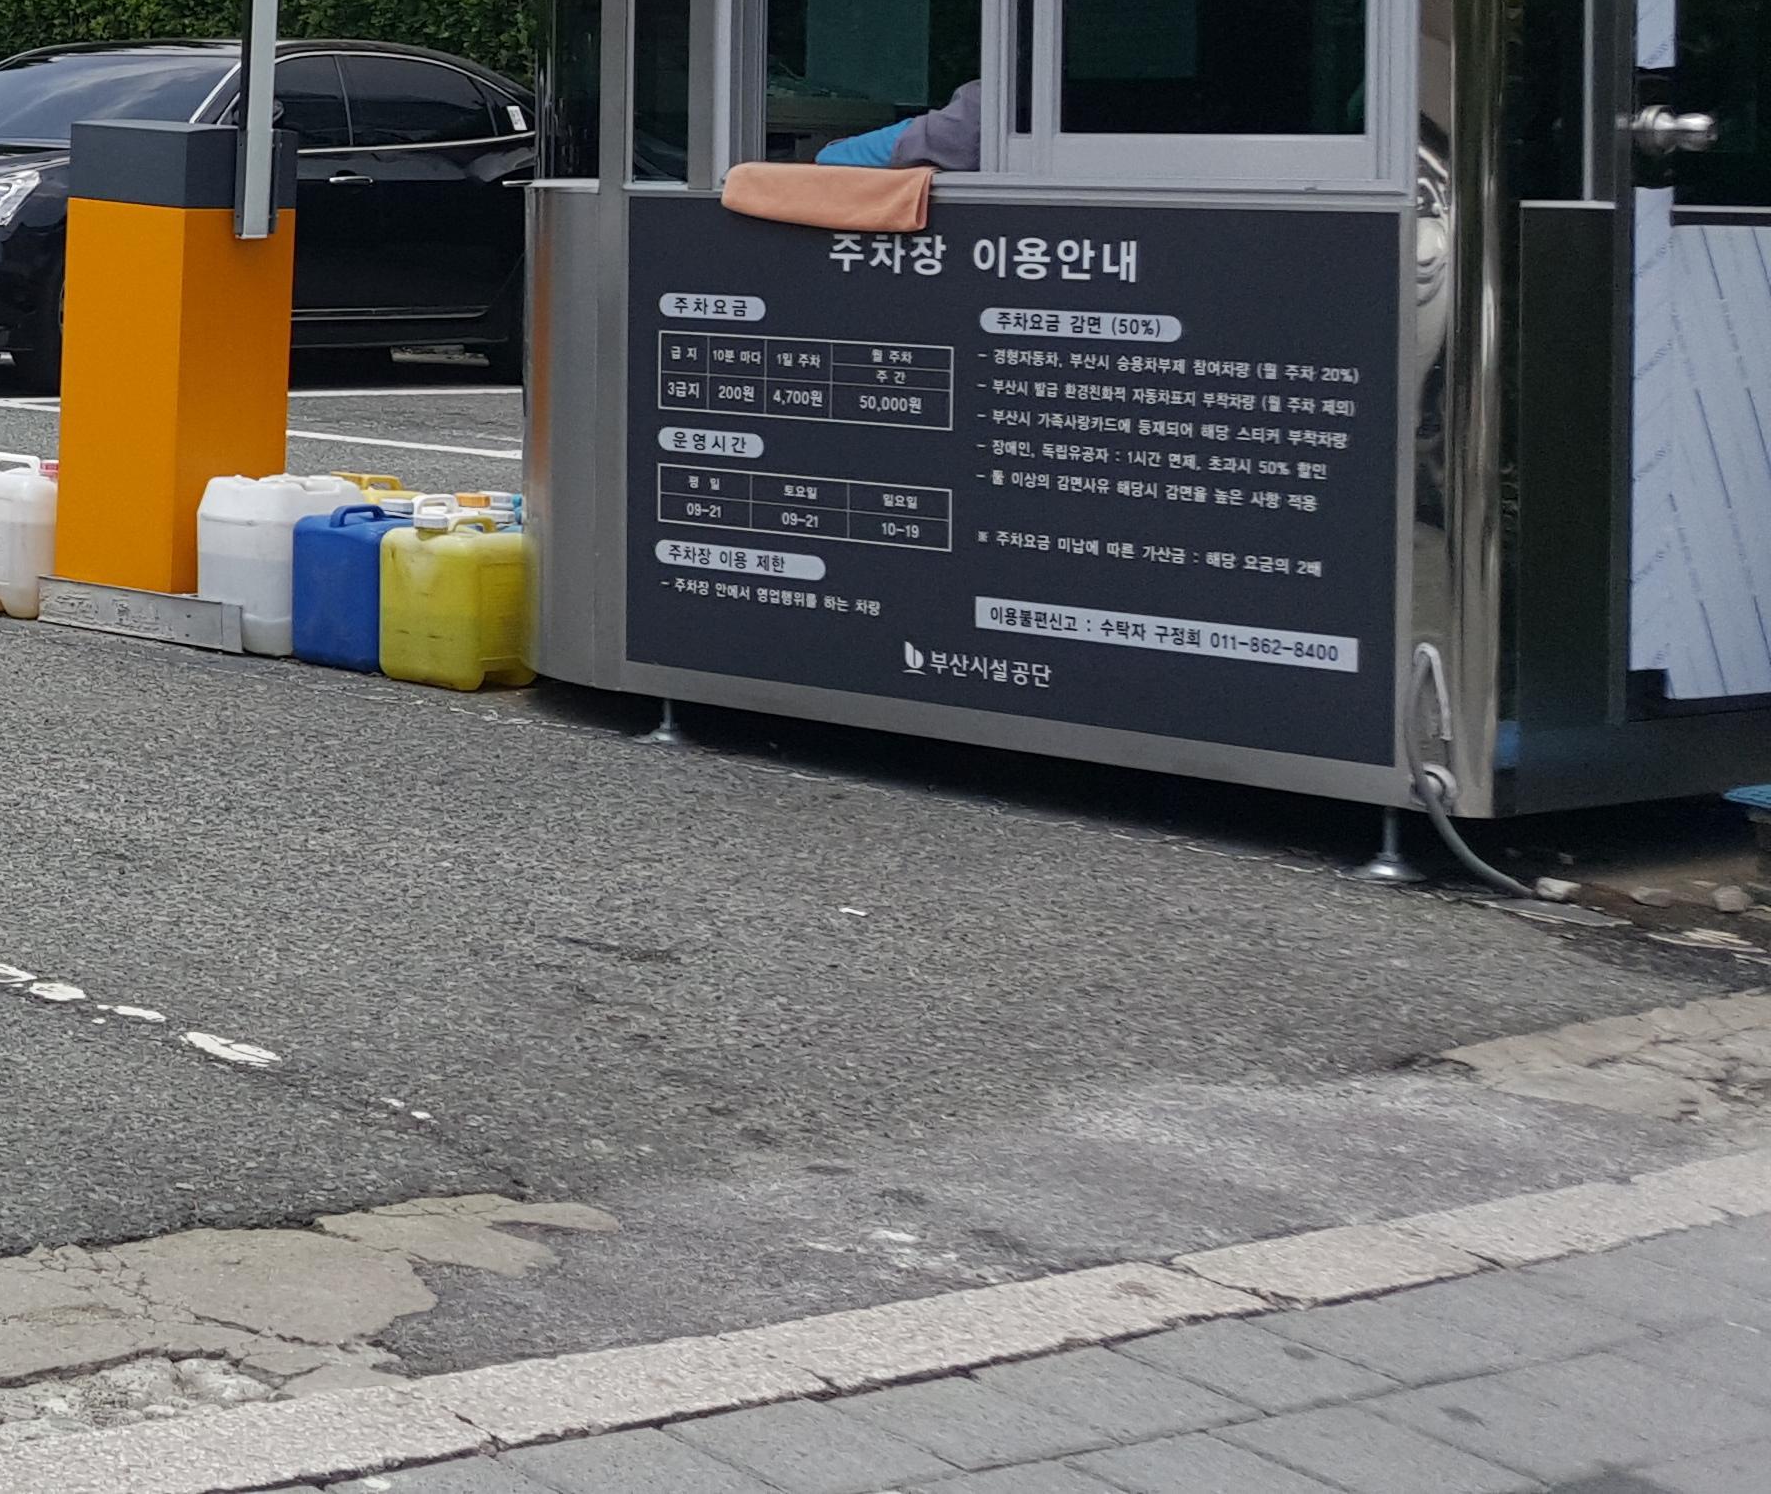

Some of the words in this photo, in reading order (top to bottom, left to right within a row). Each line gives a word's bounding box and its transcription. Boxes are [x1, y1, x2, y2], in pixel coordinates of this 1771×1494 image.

[829, 232, 947, 276] 주차장
[973, 236, 1139, 283] 이용안내
[674, 297, 748, 317] 주차요금
[997, 311, 1060, 333] 주차요금
[1070, 315, 1101, 335] 감면
[1111, 317, 1161, 338] (50%)
[739, 350, 762, 364] 마다
[798, 354, 821, 368] 주차
[888, 350, 913, 364] 주차
[1070, 353, 1110, 371] 부산시
[1193, 359, 1251, 379] 참여차량
[1284, 364, 1316, 382] 주차
[1321, 367, 1360, 385] 20%)
[667, 382, 700, 399] 3급지
[718, 385, 755, 403] 200원
[773, 389, 823, 408] 4,700원
[992, 379, 1029, 397] 부산시
[1131, 388, 1196, 407] 자동차표지
[1287, 397, 1316, 415] 주차
[859, 395, 923, 415] 50,000원
[992, 409, 1031, 427] 부산시
[1138, 419, 1193, 438] 등재되어
[1201, 424, 1230, 441] 해당
[1235, 427, 1281, 444] 스티커
[672, 430, 747, 455] 운영시간
[1042, 443, 1109, 463] 독립유공자
[1127, 451, 1162, 468] 1시간
[1209, 456, 1252, 474] 초과시
[1259, 460, 1291, 475] 50%
[783, 485, 818, 500] 토요일
[883, 493, 918, 510] 일요일
[1011, 472, 1050, 489] 이상의
[1057, 476, 1110, 494] 감면사유
[1116, 480, 1159, 499] 해당시
[1214, 488, 1244, 506] 높은
[1287, 494, 1318, 512] 적용
[686, 503, 722, 518] 09-21
[782, 512, 819, 528] 09-21
[881, 522, 920, 538] 10-19
[668, 544, 712, 566] 주차장
[720, 550, 748, 570] 이용
[756, 554, 786, 574] 제한
[996, 530, 1051, 551] 주차요금
[1058, 538, 1099, 556] 미납에
[1107, 542, 1135, 559] 따른
[1142, 546, 1186, 565] 가산금
[1206, 551, 1236, 569] 해당
[1243, 555, 1290, 574] 요금의
[674, 577, 709, 596] 주차장
[715, 581, 751, 601] 안에서
[824, 595, 849, 612] 하는
[855, 599, 881, 616] 차량
[990, 606, 1079, 633] 이용불편신고
[1100, 619, 1147, 642] 수탁자
[1210, 632, 1339, 662] 011-862-8400
[930, 650, 1052, 688] 부산시설공단
